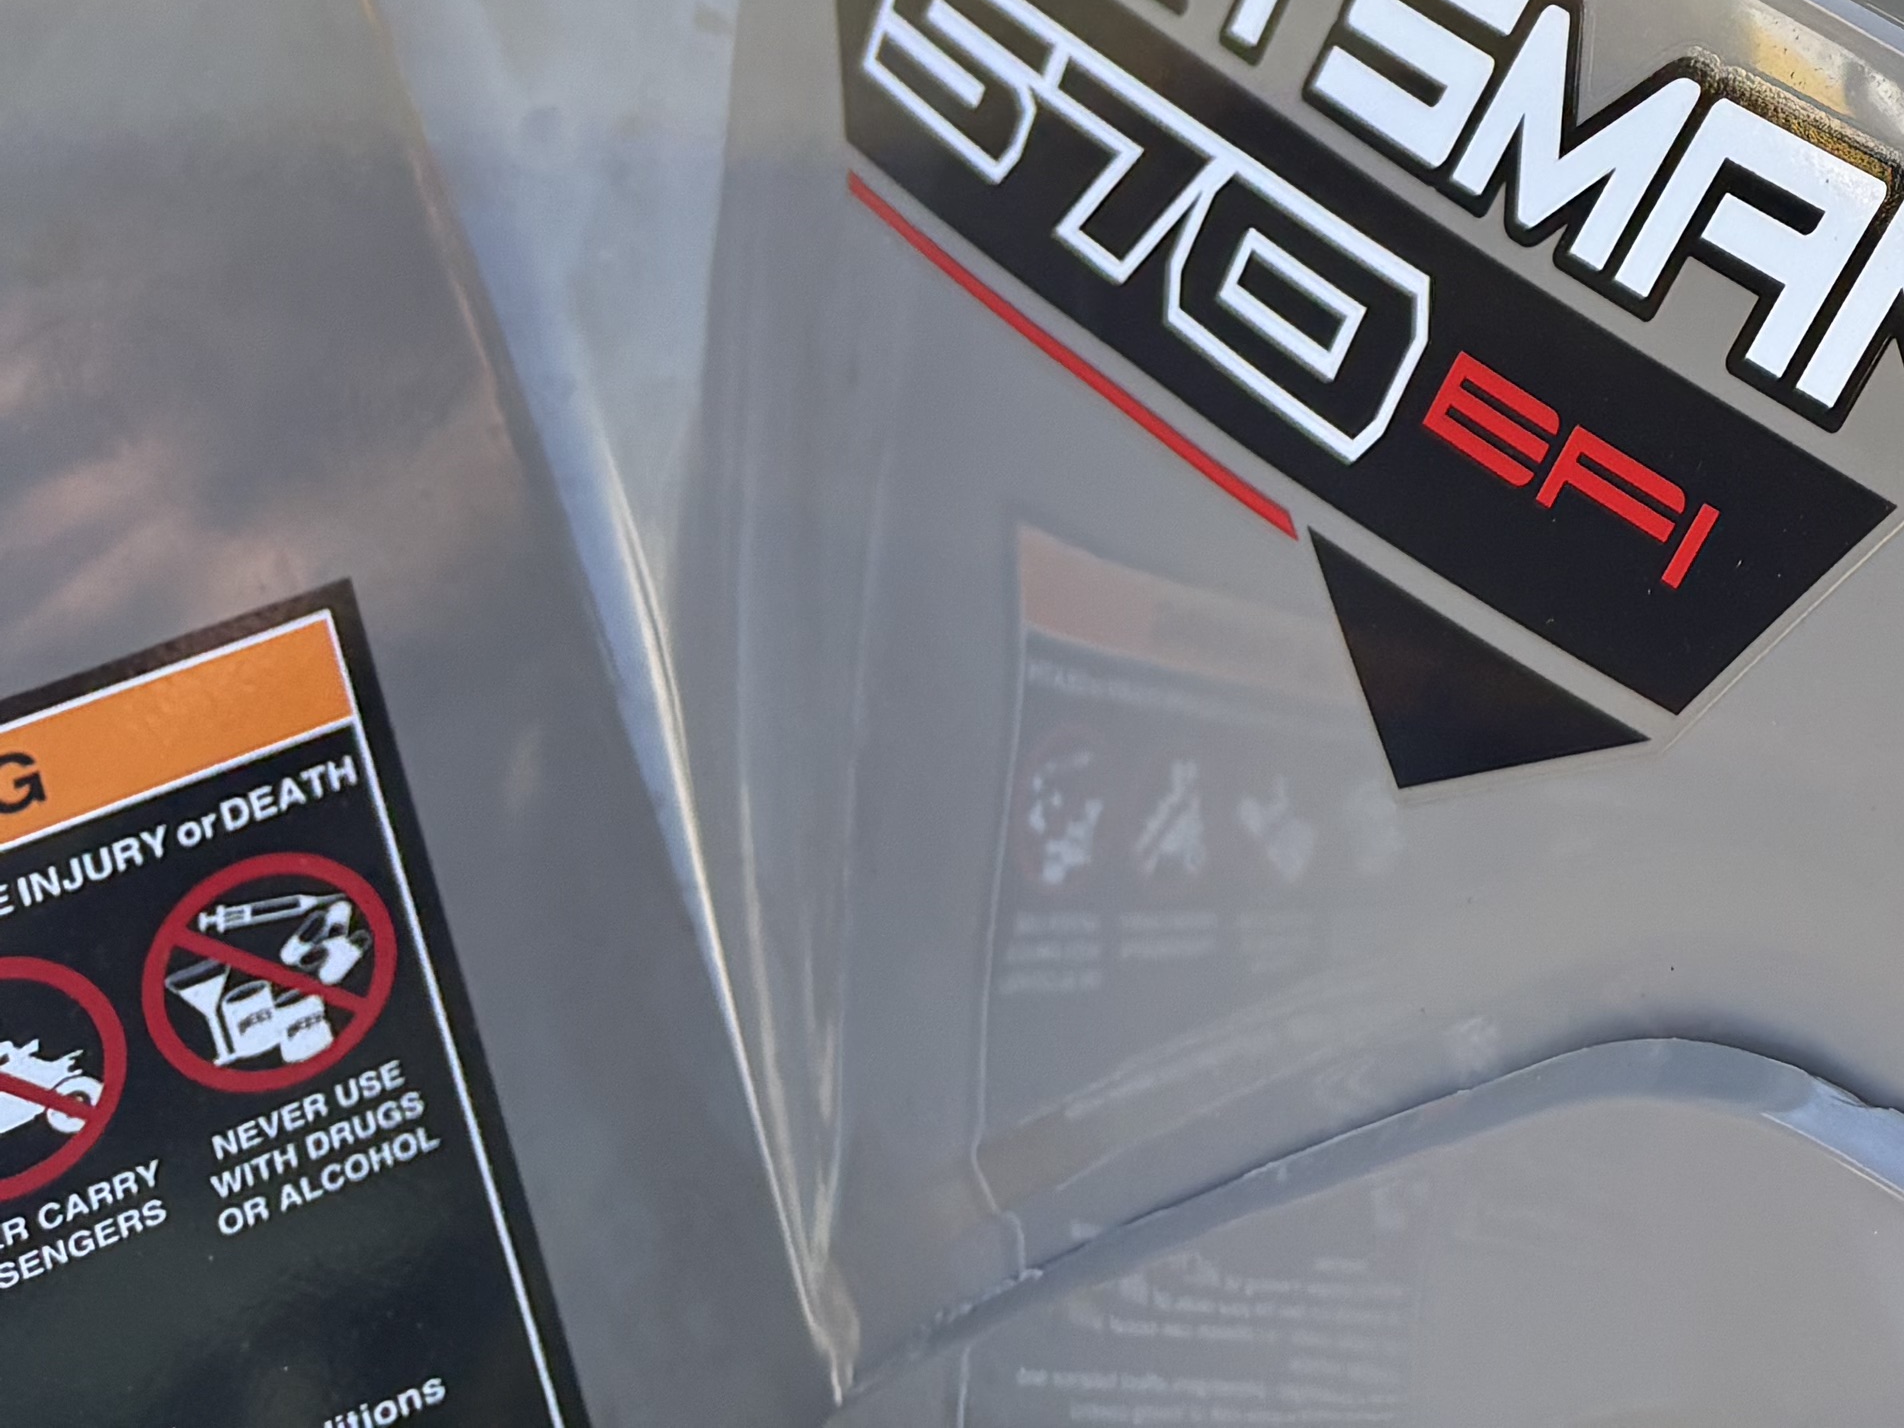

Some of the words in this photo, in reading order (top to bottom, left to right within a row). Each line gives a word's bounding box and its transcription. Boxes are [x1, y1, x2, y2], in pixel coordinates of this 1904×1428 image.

[1421, 348, 1721, 591] EFI
[16, 823, 168, 909] INJURY
[176, 811, 218, 849] or
[218, 754, 358, 833] DEATH
[209, 1143, 300, 1200] WITH
[305, 1090, 426, 1161] DRUGS
[210, 1092, 330, 1161] NEVER
[334, 1059, 406, 1109] USE
[37, 1158, 160, 1231] CARRY
[216, 1196, 270, 1237] OR
[279, 1125, 441, 1214] ALCOHOL
